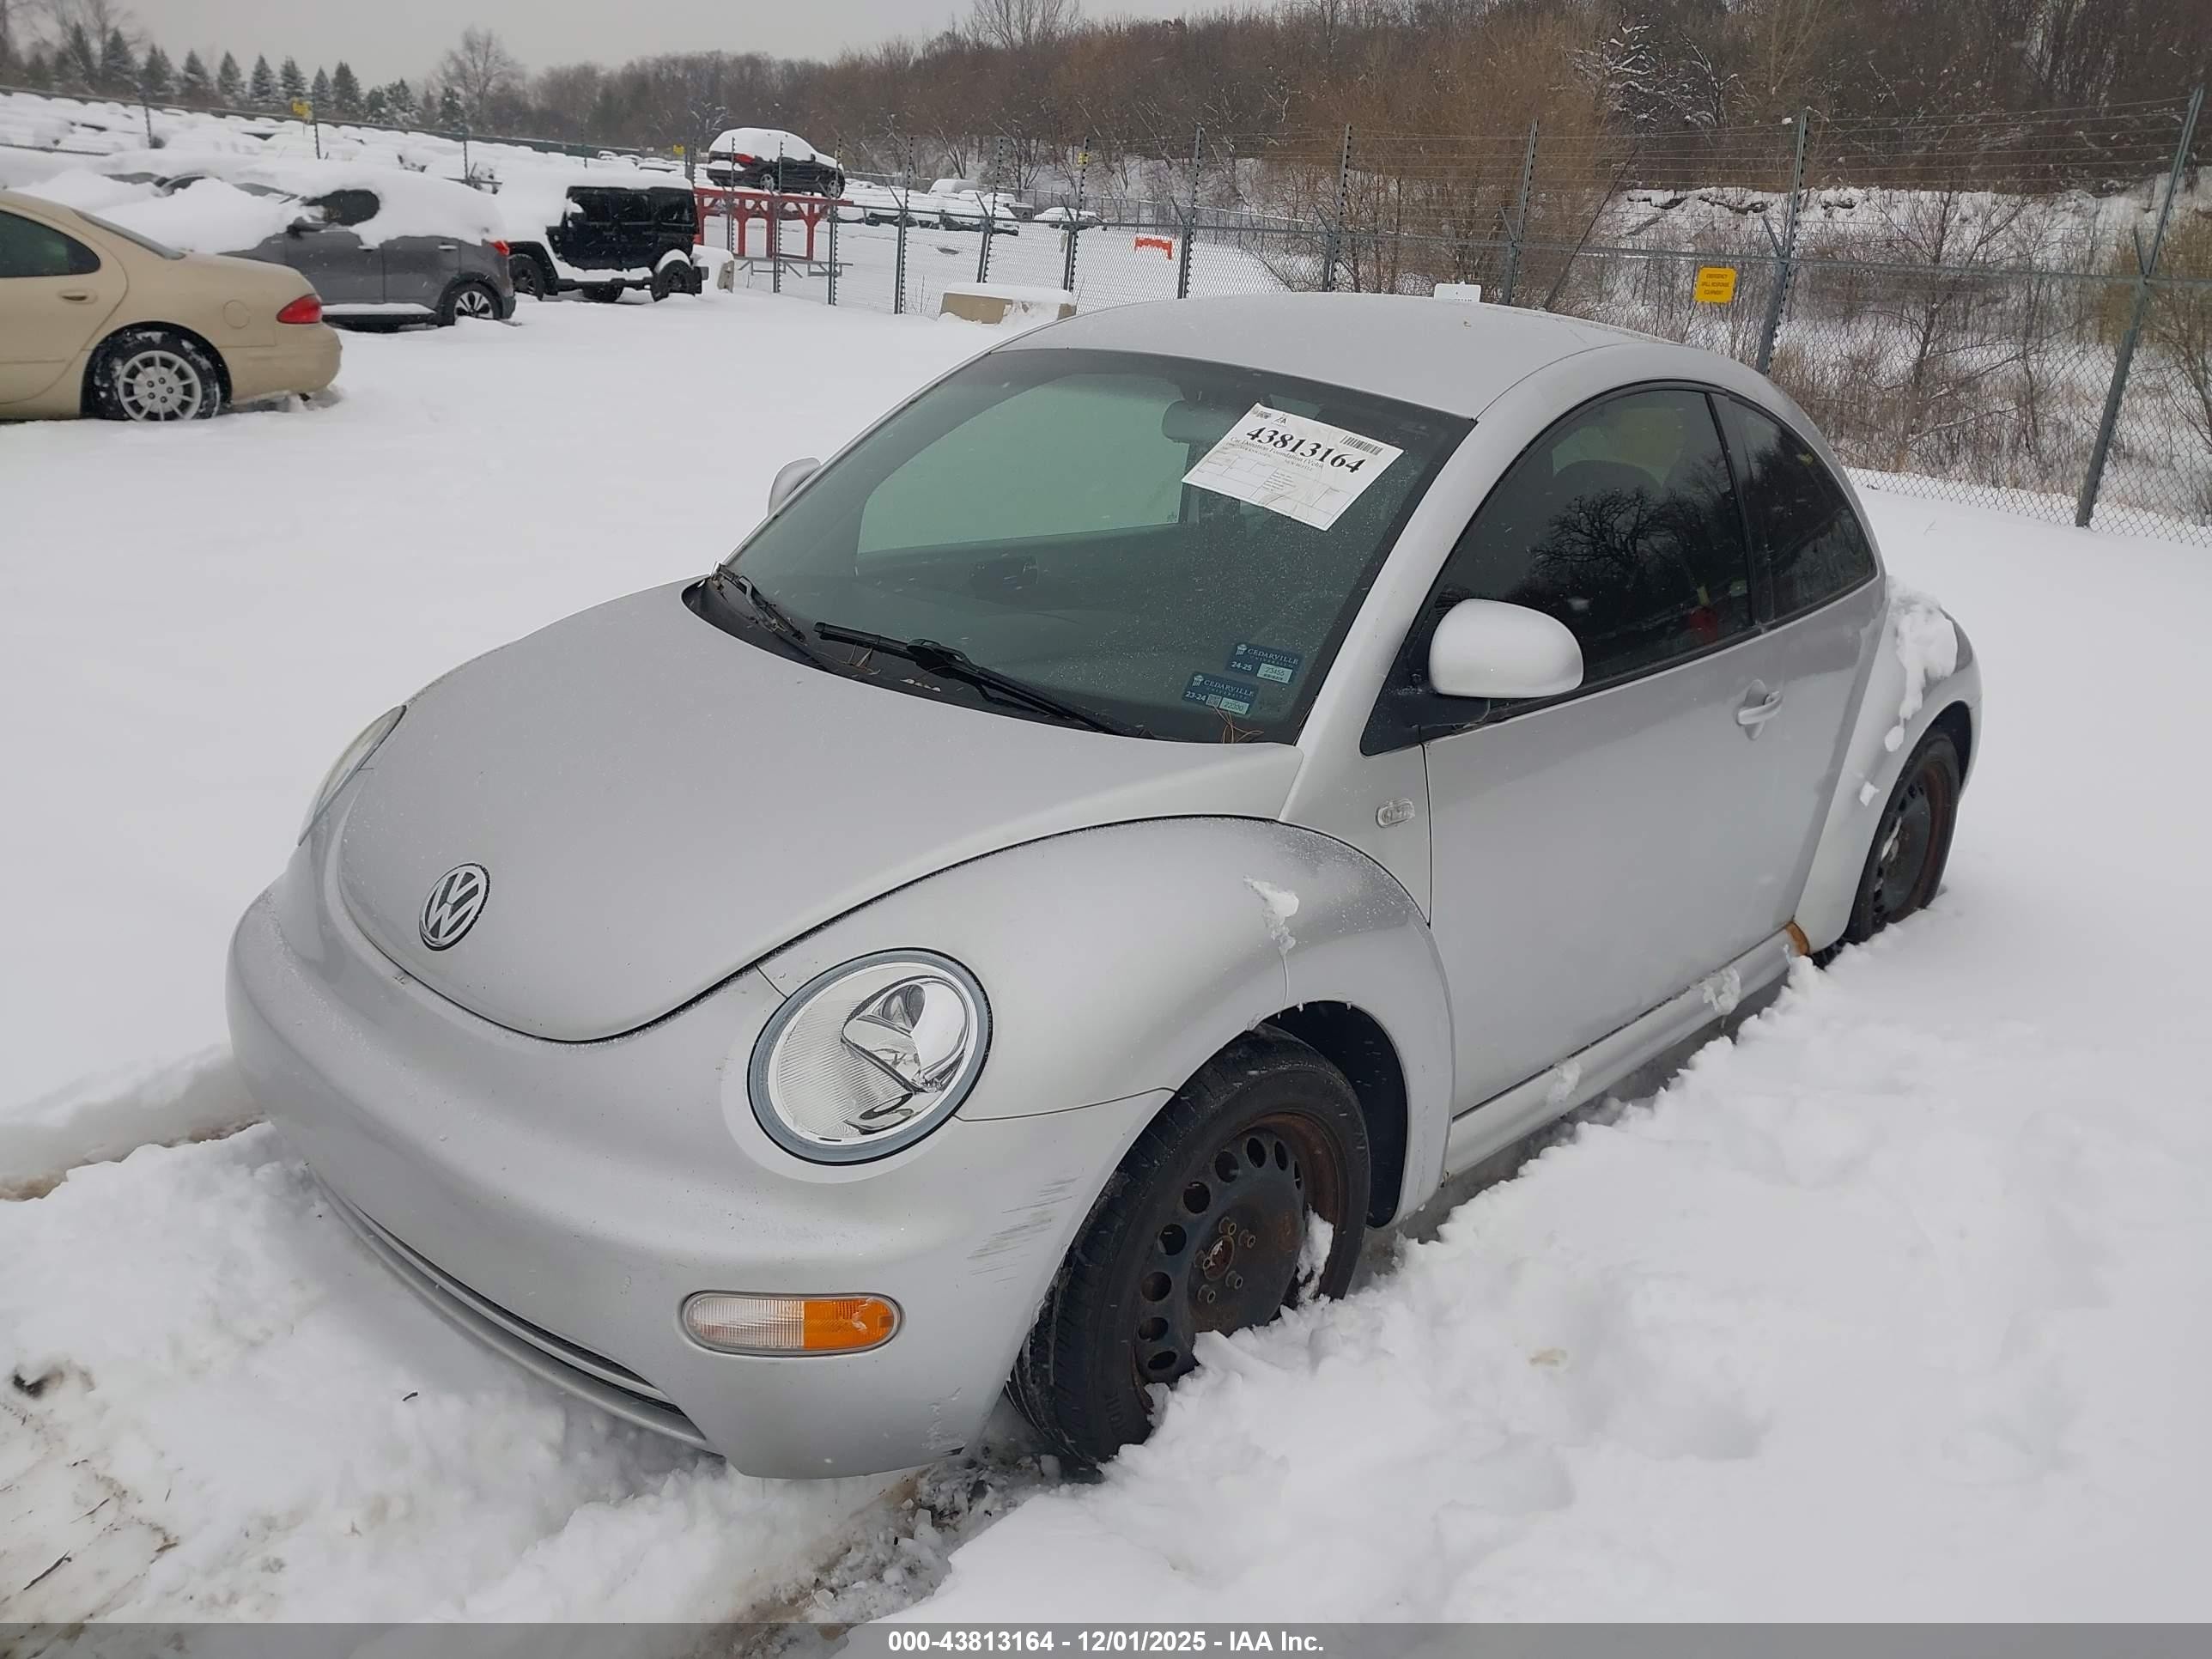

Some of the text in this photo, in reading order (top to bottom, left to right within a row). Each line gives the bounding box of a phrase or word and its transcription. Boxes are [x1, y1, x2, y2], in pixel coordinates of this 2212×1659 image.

[1246, 427, 1366, 473] 43813164
[1269, 447, 1303, 462] Foundation
[1247, 648, 1299, 665] CEDARVILLE
[1231, 661, 1253, 672] 24-25
[1203, 679, 1255, 696] CEDARVILLE
[1185, 690, 1206, 702] 23-24
